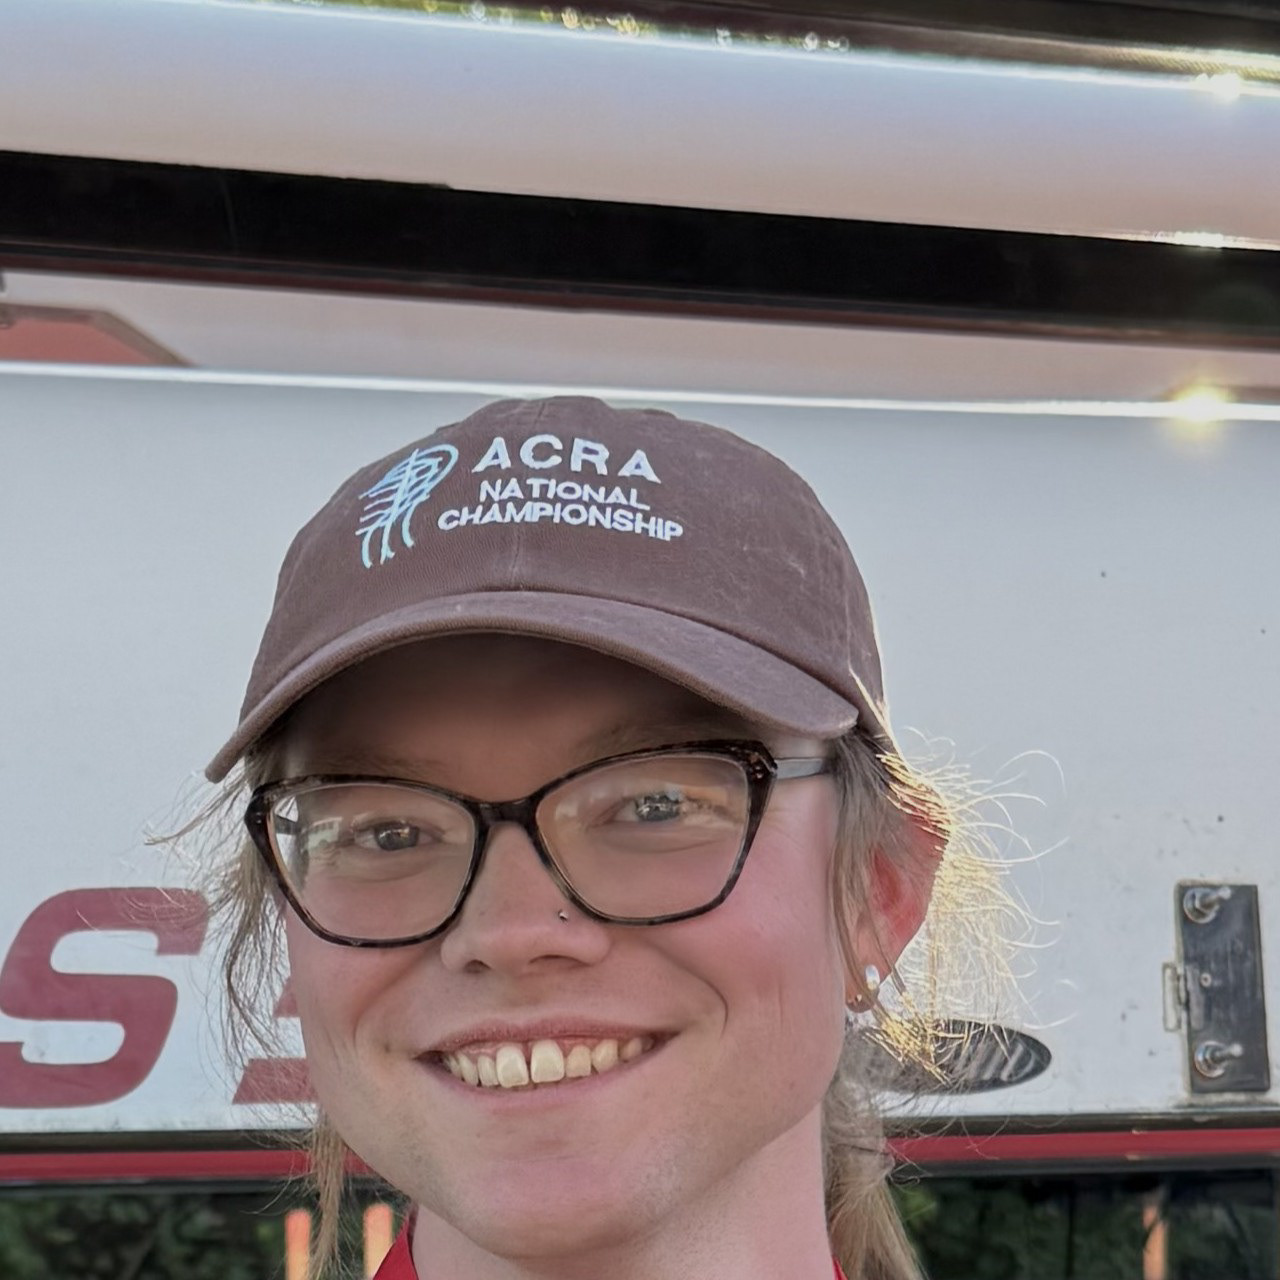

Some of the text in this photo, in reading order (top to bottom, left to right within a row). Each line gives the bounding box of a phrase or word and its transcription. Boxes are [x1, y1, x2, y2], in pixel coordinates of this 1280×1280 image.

[472, 433, 662, 483] ACRA
[479, 477, 651, 511] NATIONAL
[437, 501, 684, 542] CHAMPIONSHIP
